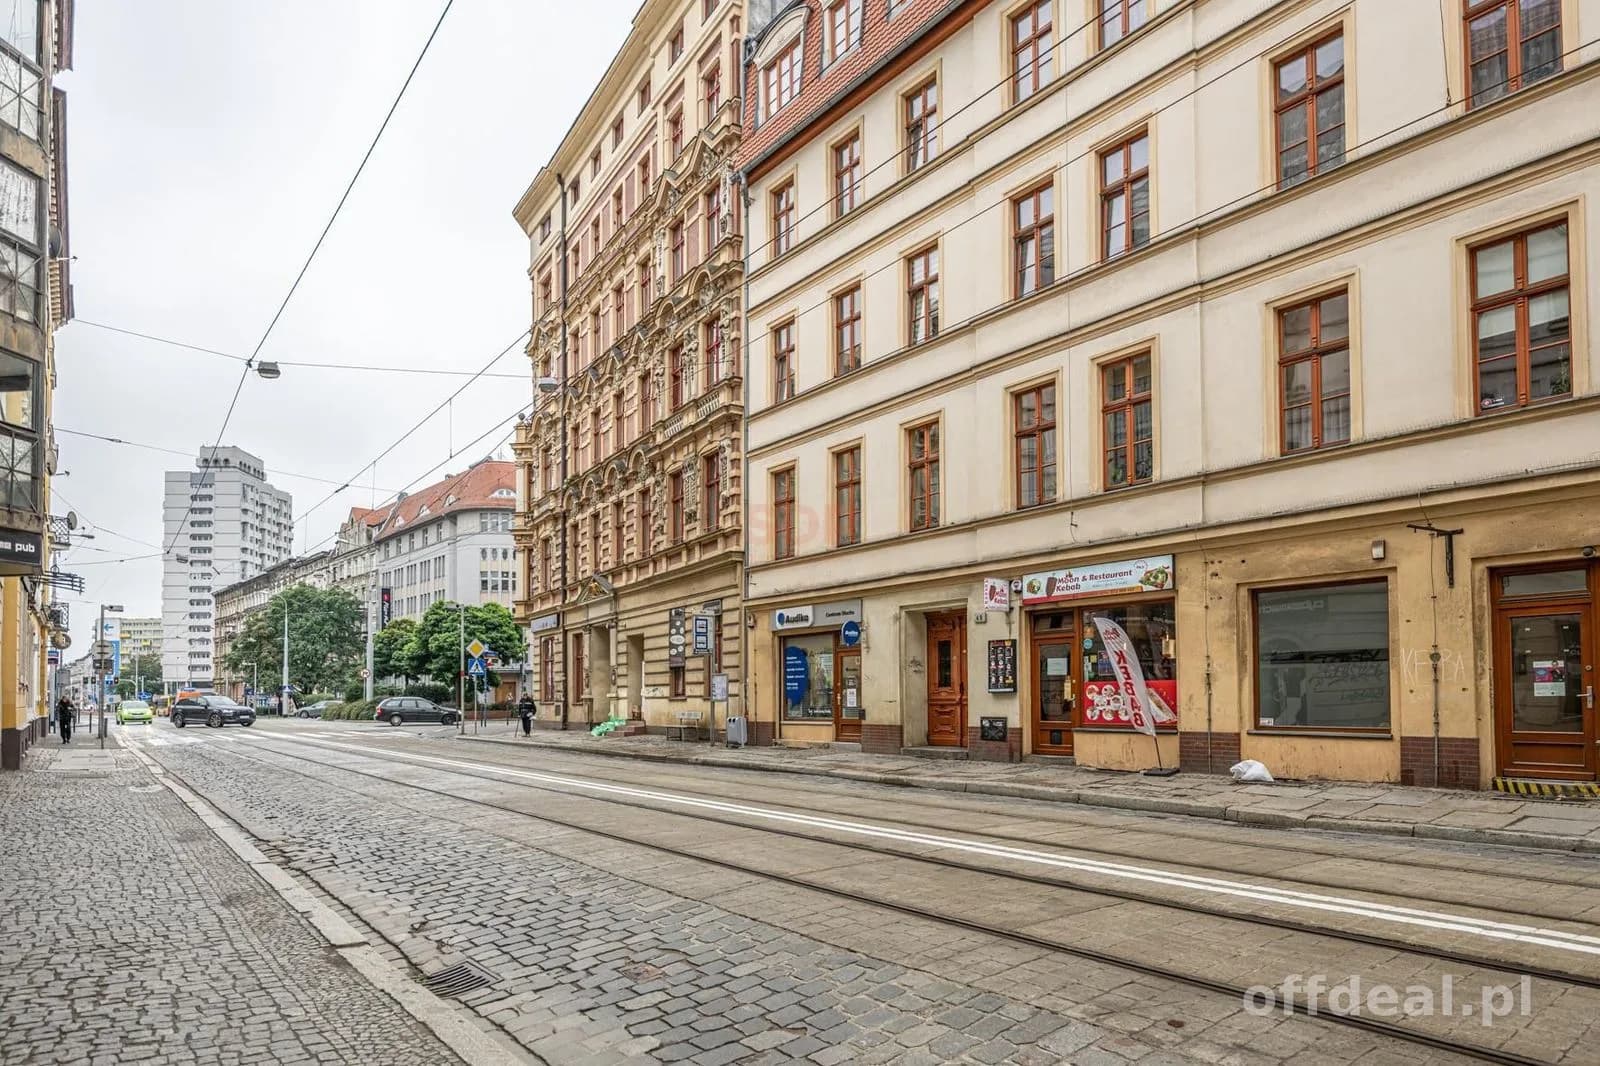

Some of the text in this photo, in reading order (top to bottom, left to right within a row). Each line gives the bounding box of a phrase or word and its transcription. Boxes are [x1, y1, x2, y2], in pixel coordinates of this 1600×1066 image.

[15, 543, 35, 552] pub
[1057, 569, 1133, 585] Moon & Restaurant
[1056, 583, 1081, 592] Kebab
[785, 613, 809, 624] Audika
